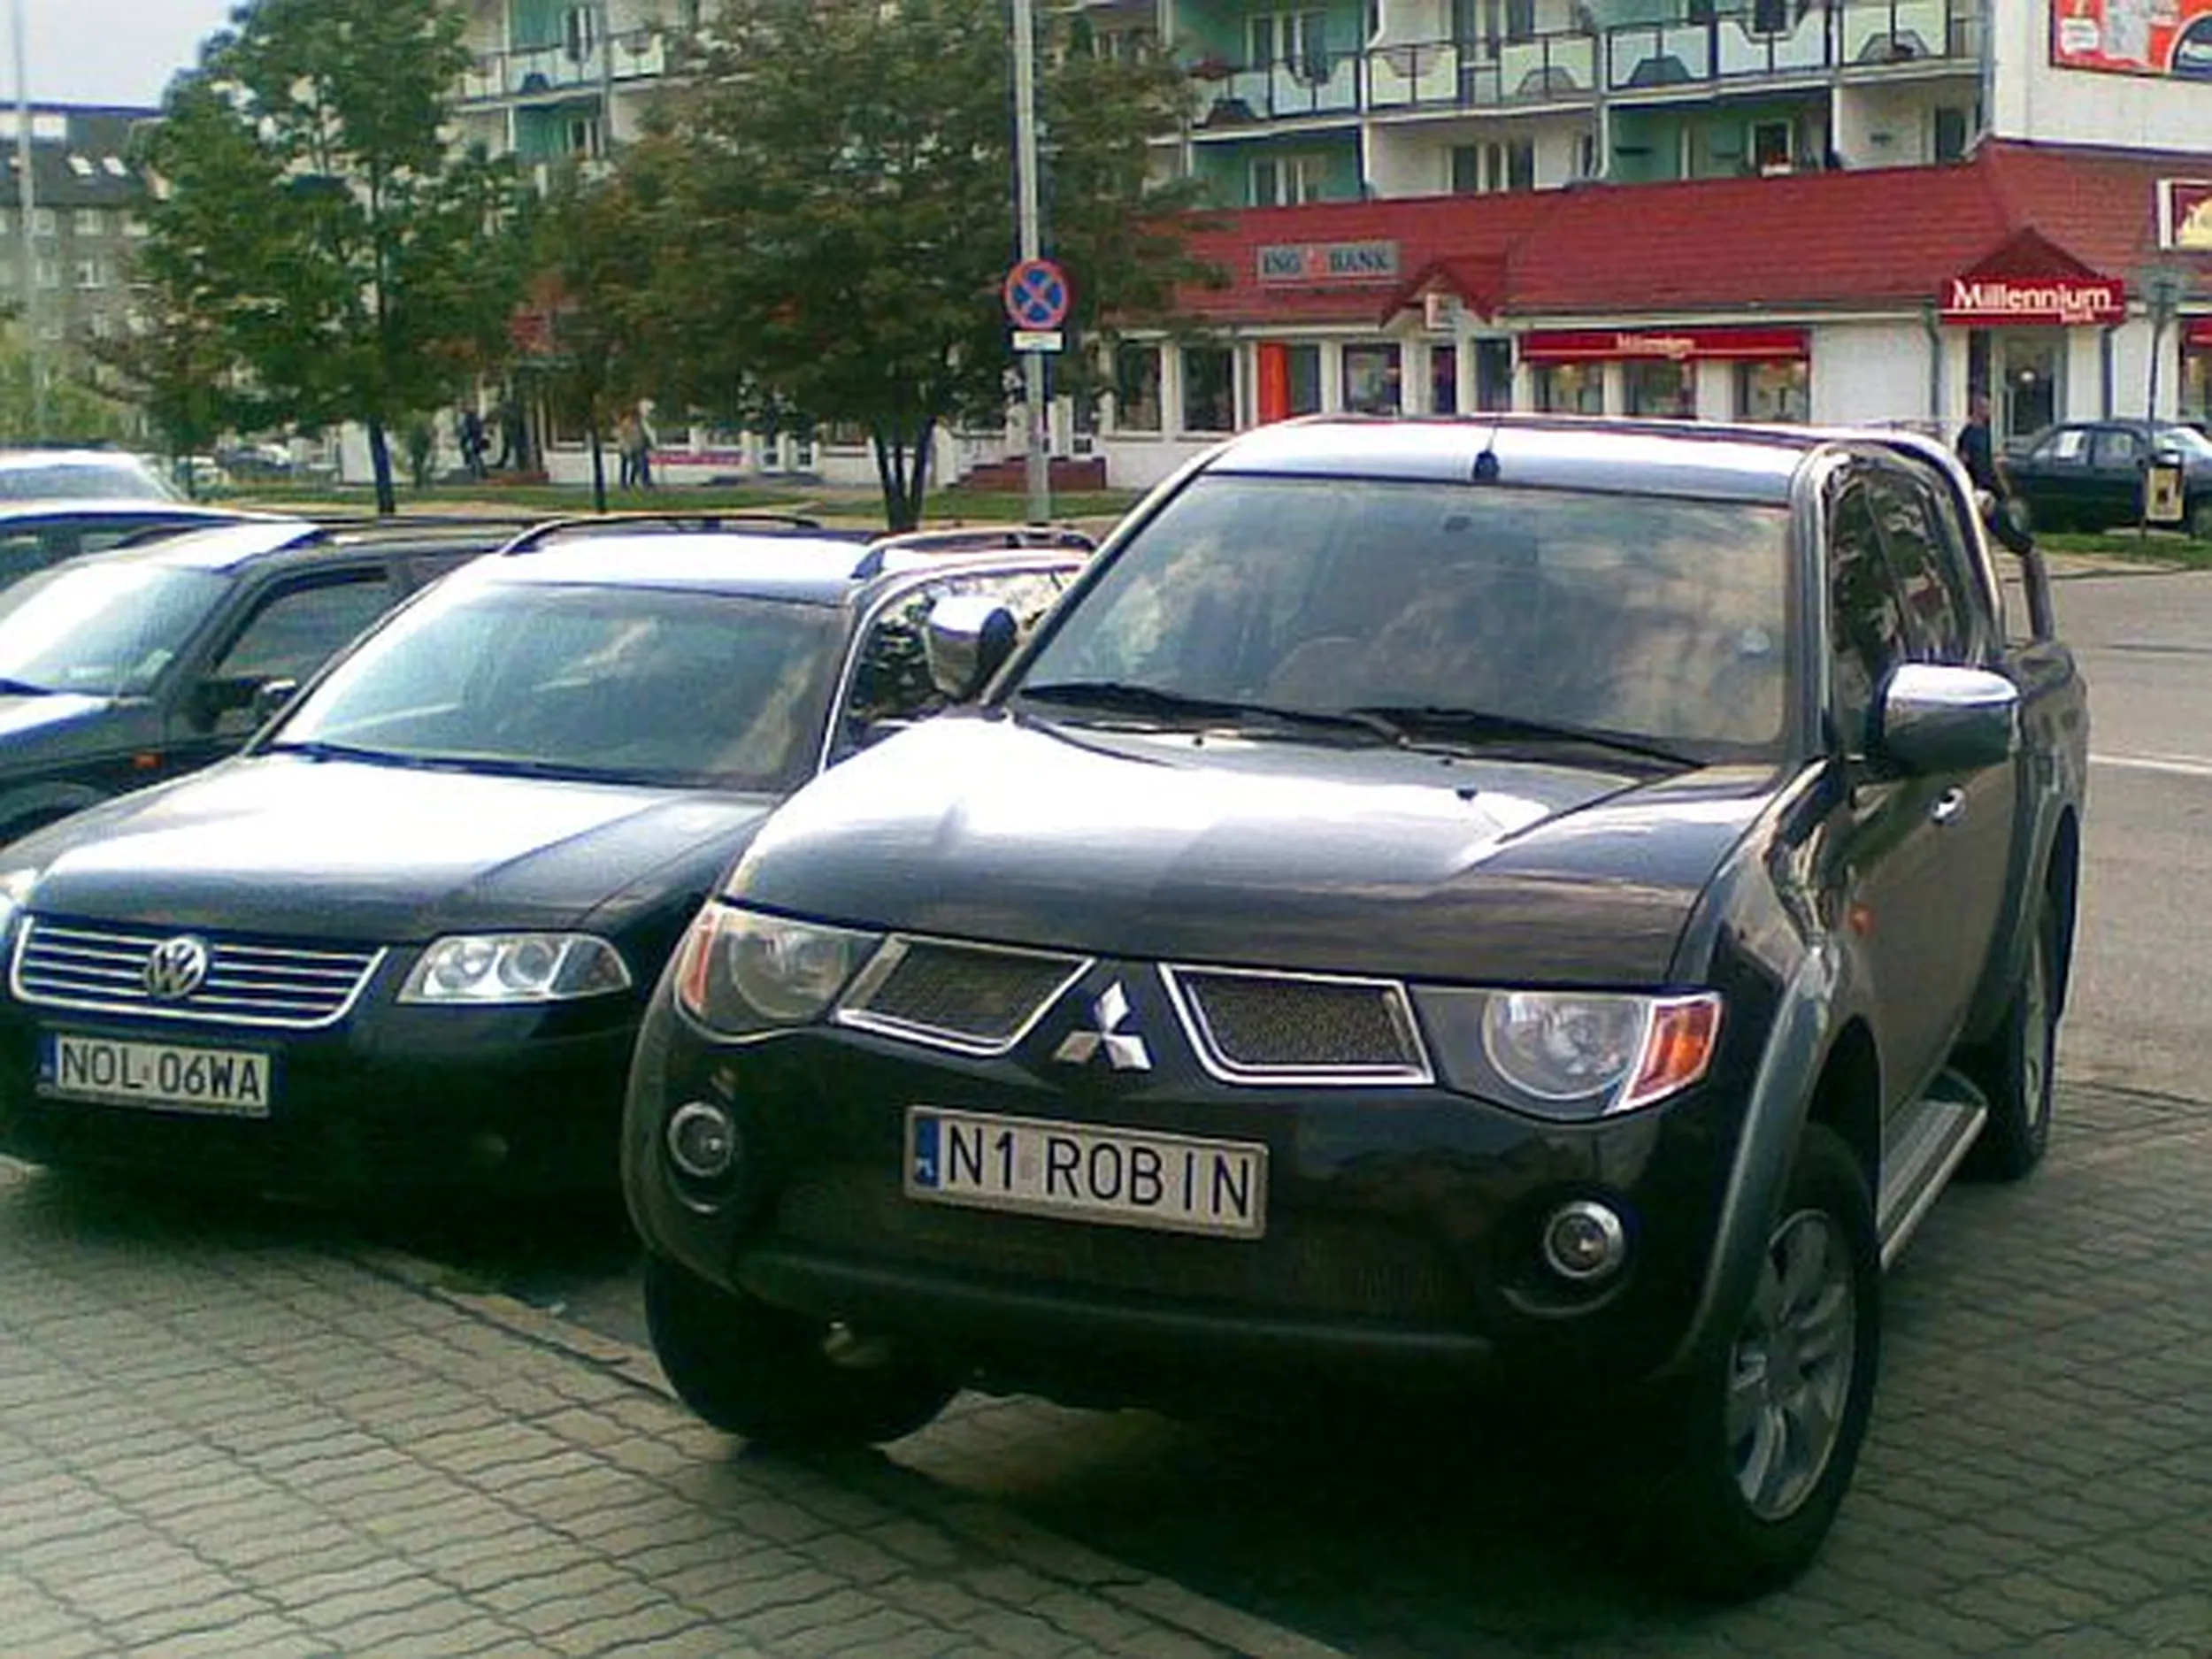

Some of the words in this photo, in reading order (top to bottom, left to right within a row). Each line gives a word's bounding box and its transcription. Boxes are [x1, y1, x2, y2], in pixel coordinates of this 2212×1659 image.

[1263, 249, 1301, 274] ING
[1952, 279, 2110, 309] Millennium
[61, 1042, 145, 1089] NOL
[949, 1124, 1015, 1191] N1
[1046, 1136, 1250, 1218] ROBIN
